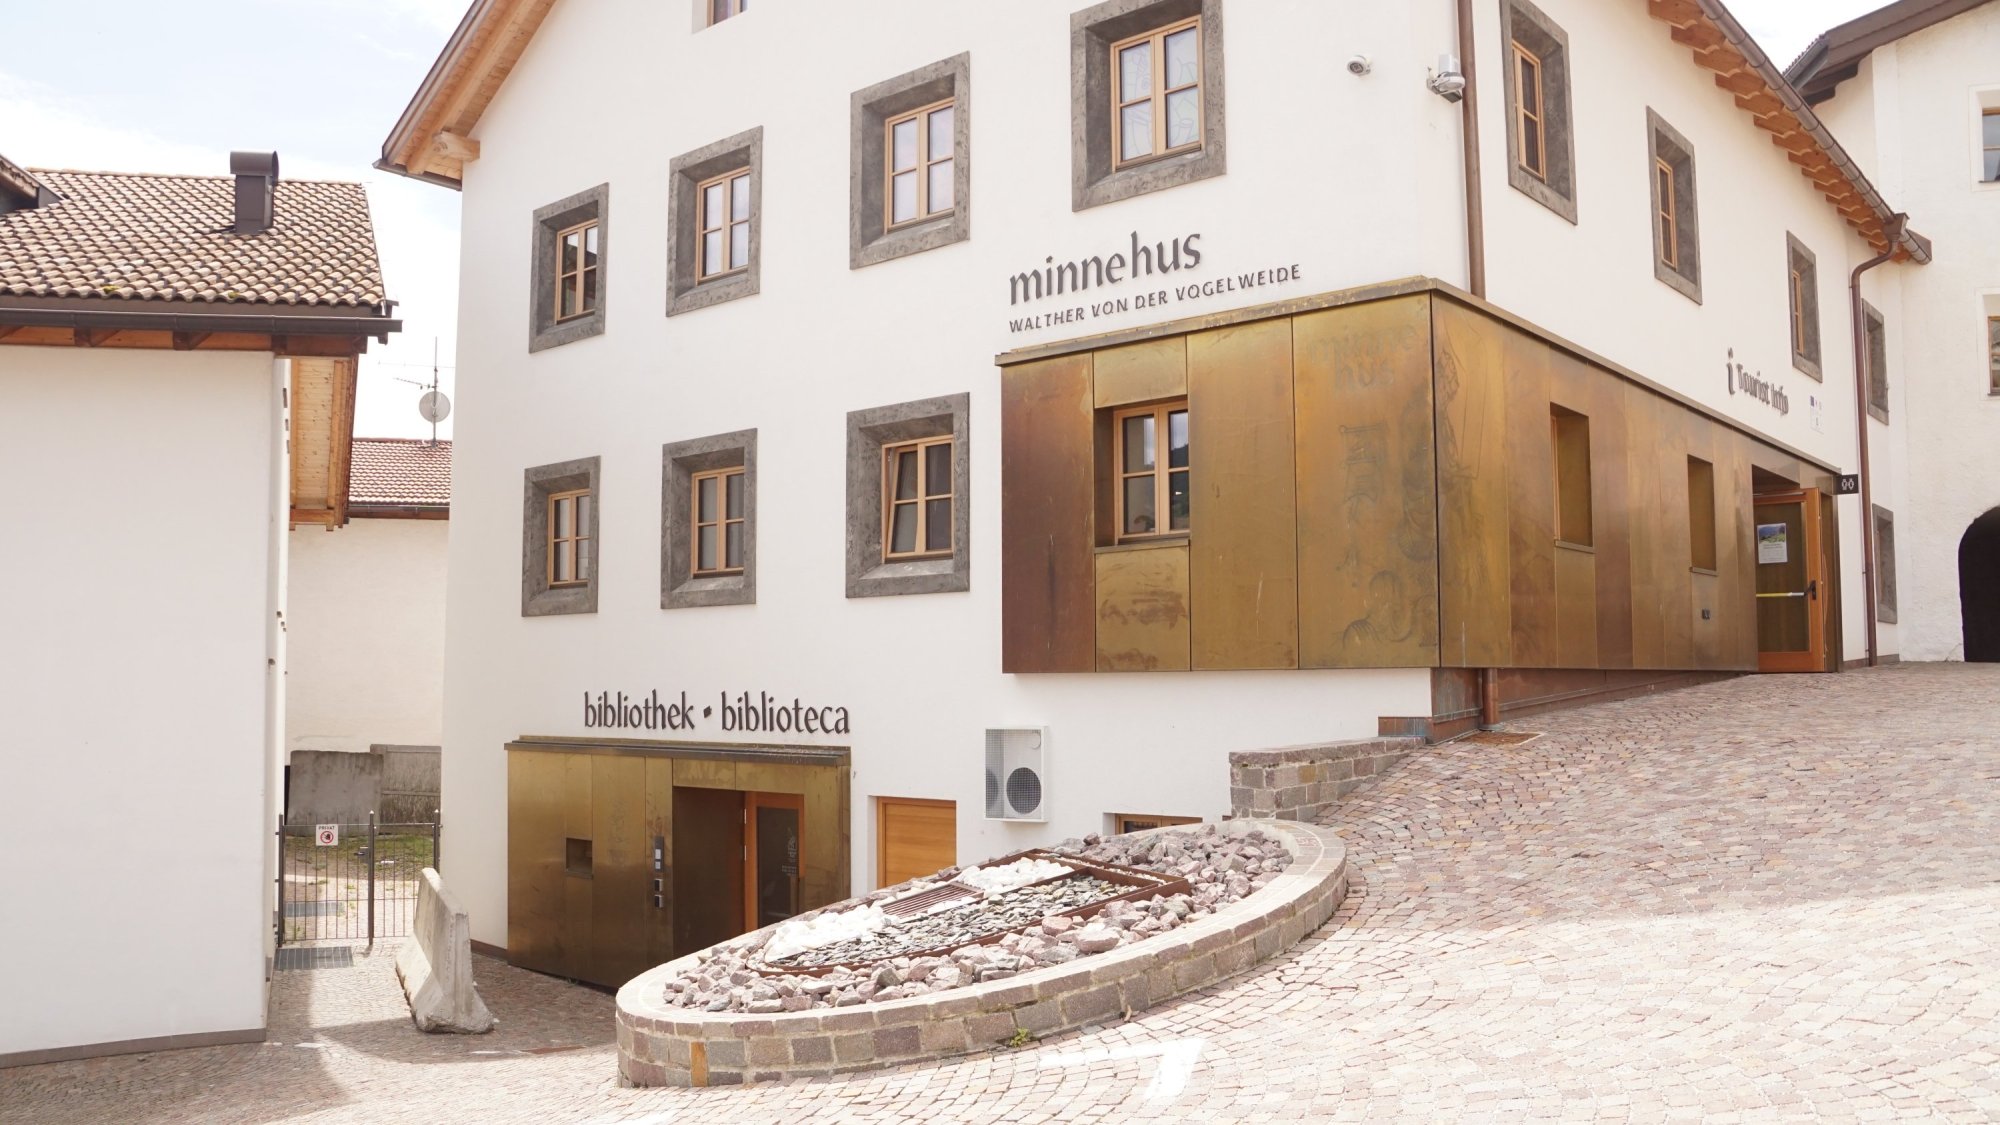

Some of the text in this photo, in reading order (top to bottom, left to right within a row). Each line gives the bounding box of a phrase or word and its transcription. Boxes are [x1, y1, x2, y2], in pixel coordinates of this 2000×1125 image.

[1009, 230, 1201, 306] minnehus
[1009, 264, 1301, 333] WALTHER VON DER VOGELWEIDE
[1736, 363, 1770, 405] Tourist
[584, 689, 850, 734] bibliothek biblioteca
